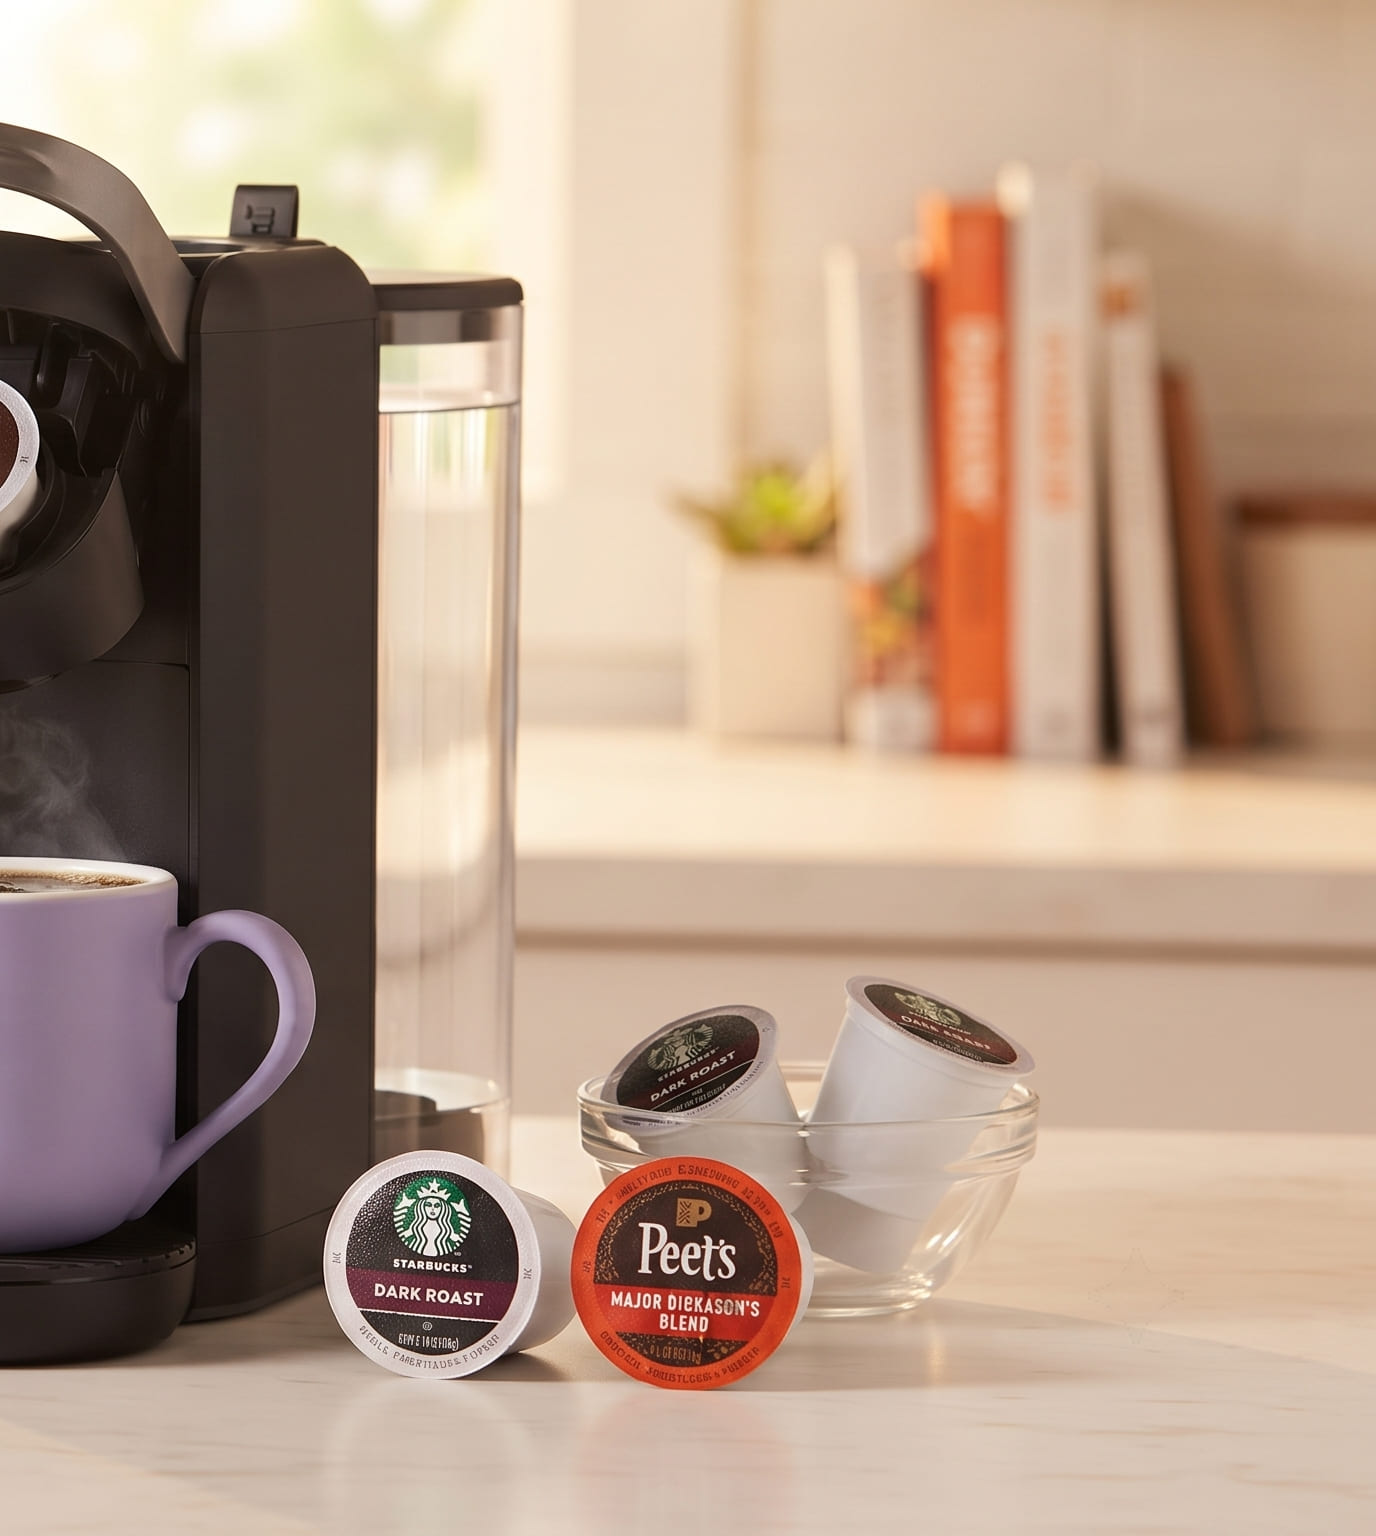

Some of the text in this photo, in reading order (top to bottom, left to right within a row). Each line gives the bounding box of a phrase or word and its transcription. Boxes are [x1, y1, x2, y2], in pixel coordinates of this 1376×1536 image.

[650, 1078, 688, 1102] DARK
[690, 1050, 736, 1082] ROAST
[637, 1222, 737, 1282] Peet's
[393, 1258, 468, 1273] STARBUCKS
[374, 1283, 484, 1306] DARK ROAST
[610, 1291, 662, 1310] MAJOR
[659, 1313, 709, 1333] BLEND
